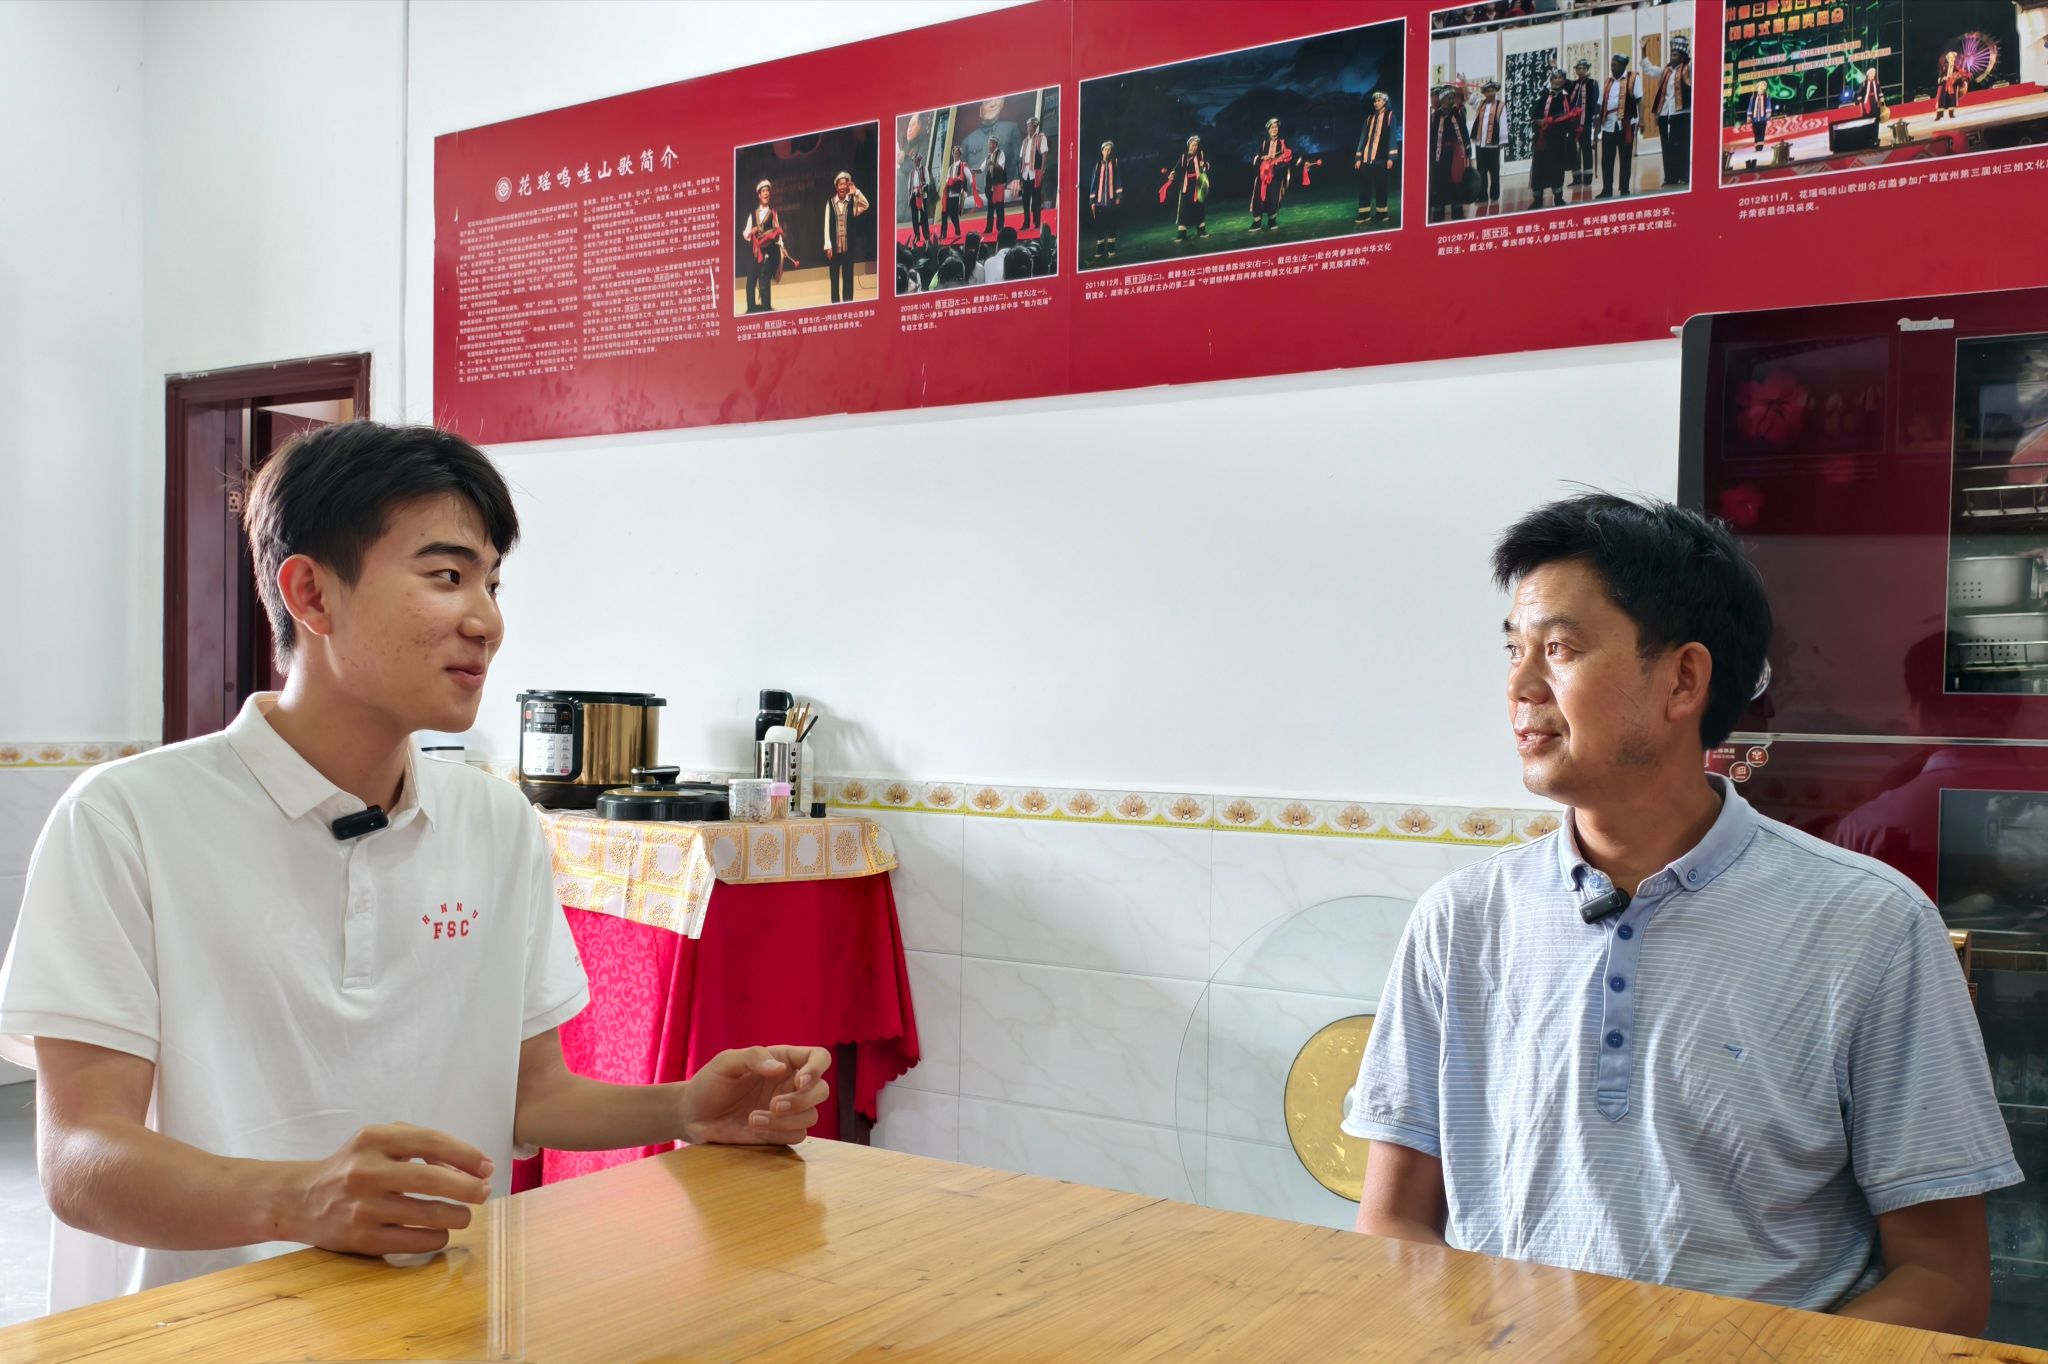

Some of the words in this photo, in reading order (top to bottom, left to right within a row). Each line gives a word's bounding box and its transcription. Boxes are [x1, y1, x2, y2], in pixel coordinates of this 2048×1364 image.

[517, 145, 679, 197] 花瑶呜哇山歌简介
[1738, 158, 2048, 206] 2012年11月，花瑶呜哇山歌组合应邀参加广西宜州第三届刘三姐文化
[433, 919, 470, 940] FSC
